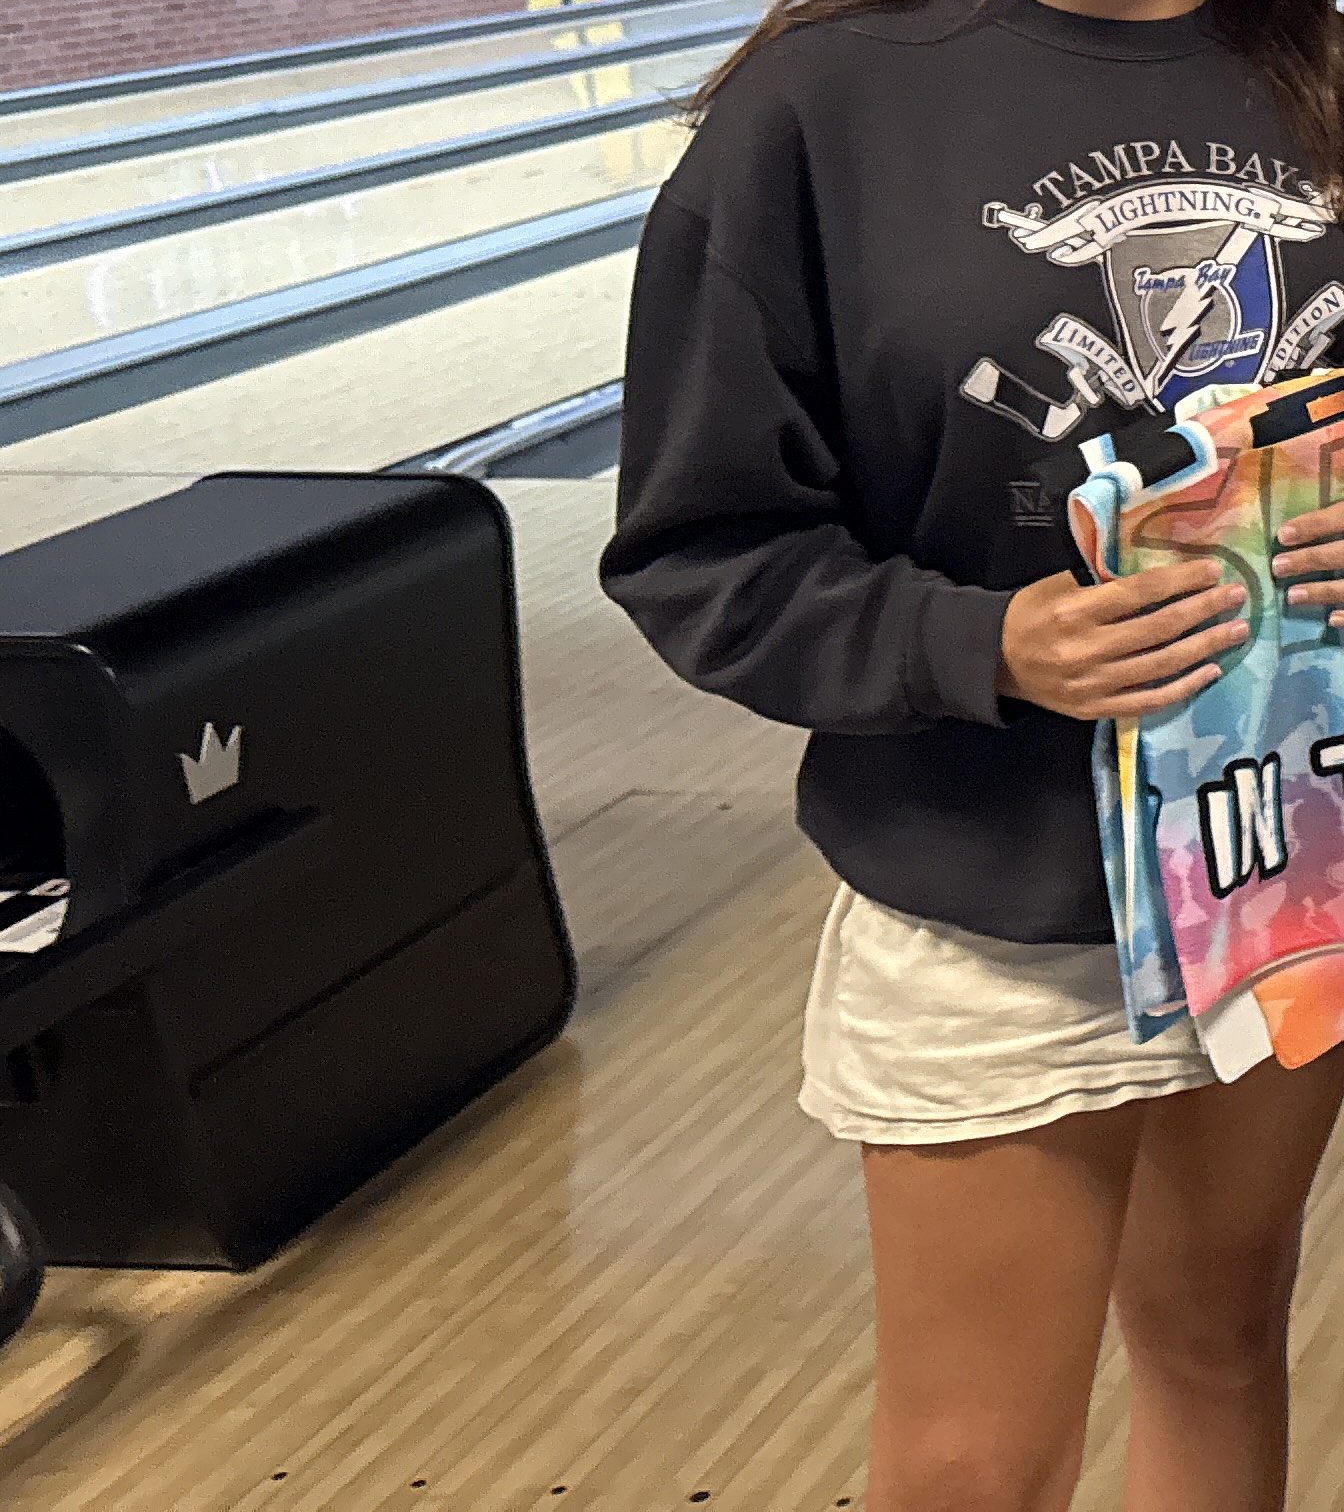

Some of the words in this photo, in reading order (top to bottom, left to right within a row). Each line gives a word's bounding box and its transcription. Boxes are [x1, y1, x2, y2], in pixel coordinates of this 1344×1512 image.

[1032, 139, 1196, 209] TAMPA
[1205, 141, 1299, 194] BAY
[1098, 190, 1255, 234] LIGHTNING
[1137, 269, 1187, 293] Tampa
[1051, 320, 1137, 393] LIMITED
[1272, 291, 1341, 366] DITION
[1196, 750, 1288, 899] IN
